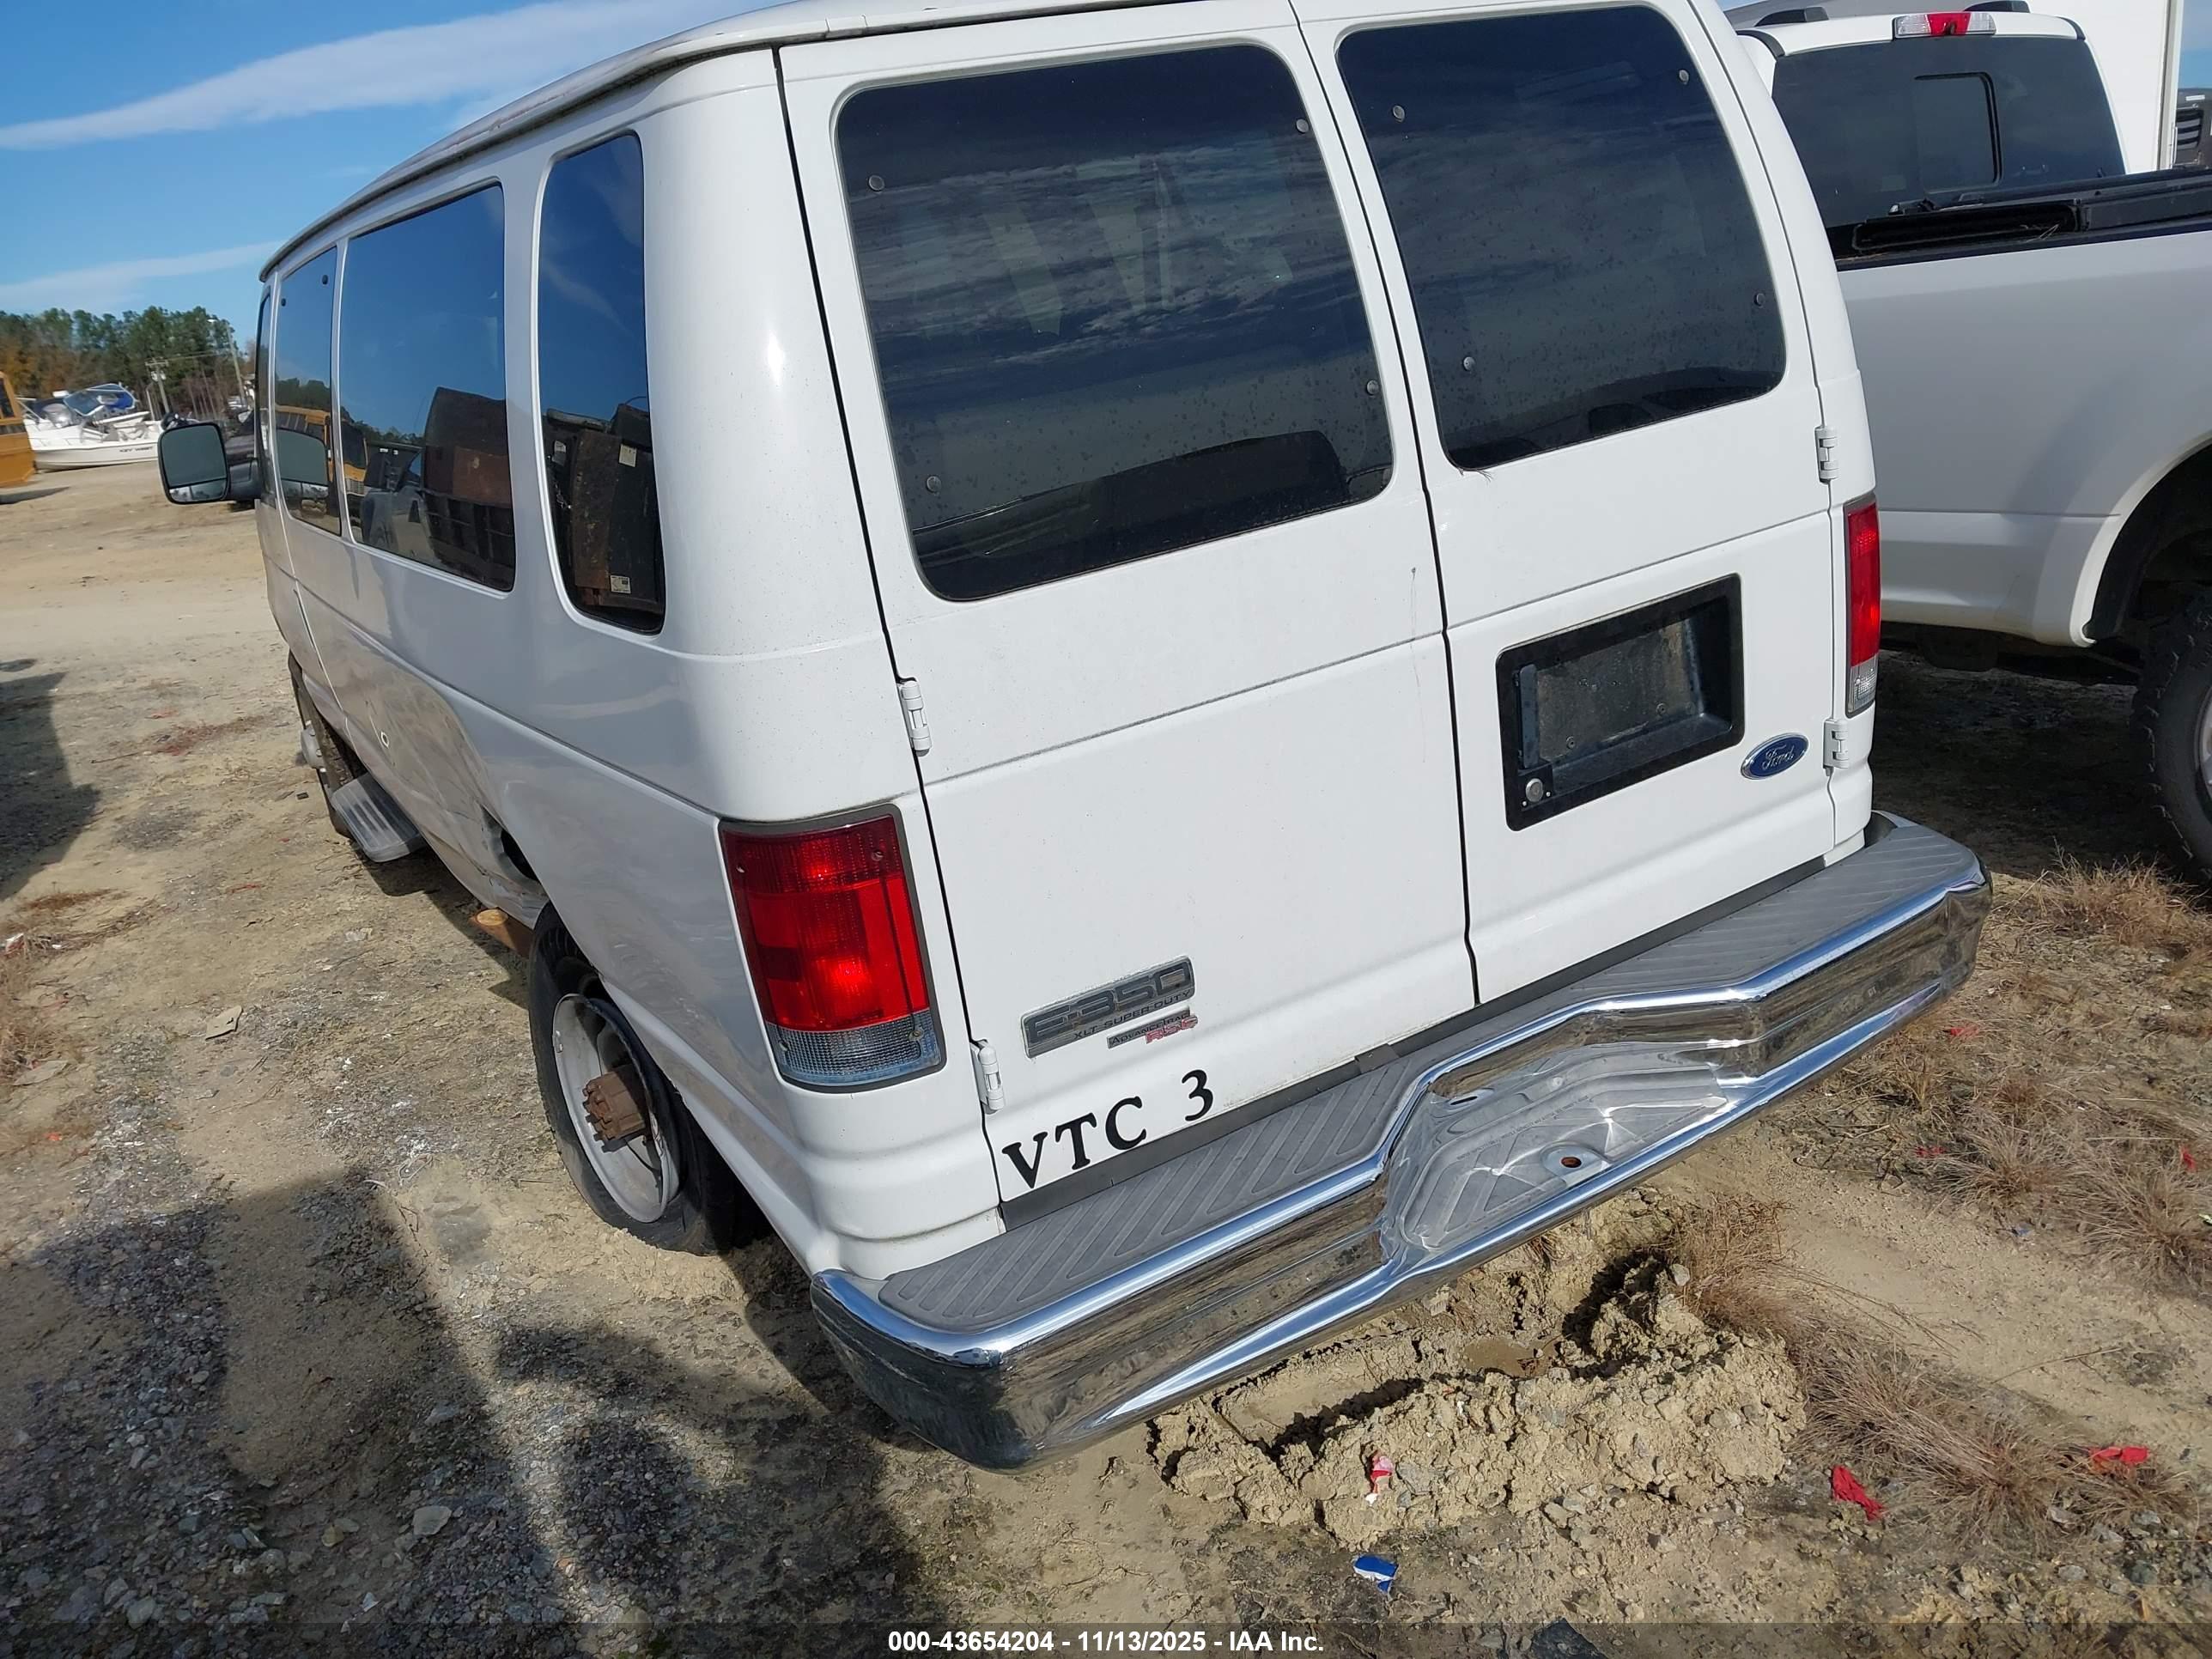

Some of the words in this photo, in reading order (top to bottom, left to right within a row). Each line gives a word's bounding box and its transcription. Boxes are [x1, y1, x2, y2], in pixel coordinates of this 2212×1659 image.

[1761, 744, 1796, 771] Ford
[1073, 1025, 1097, 1041] XLT
[1104, 1006, 1151, 1028] SUPER
[1152, 988, 1192, 1008] DUTY
[1146, 1015, 1199, 1045] RSC
[1001, 1096, 1147, 1189] VTC
[1181, 1068, 1214, 1122] 3
